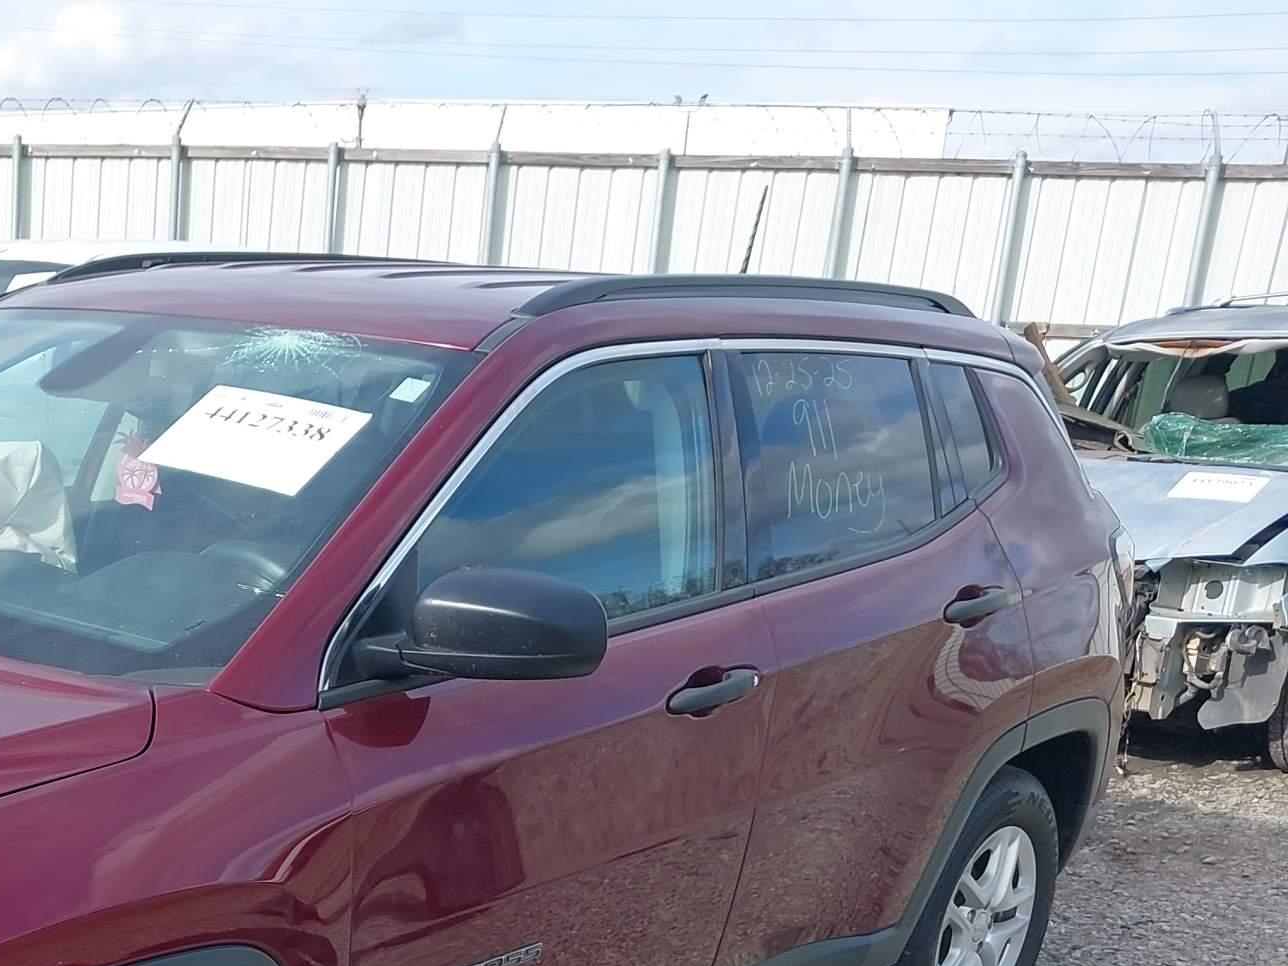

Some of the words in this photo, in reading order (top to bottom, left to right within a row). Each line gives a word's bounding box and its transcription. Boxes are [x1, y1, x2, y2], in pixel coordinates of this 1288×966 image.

[751, 357, 853, 396] 12-25-25
[204, 406, 331, 441] 44127338
[792, 399, 838, 461] 911
[787, 461, 886, 534] Money
